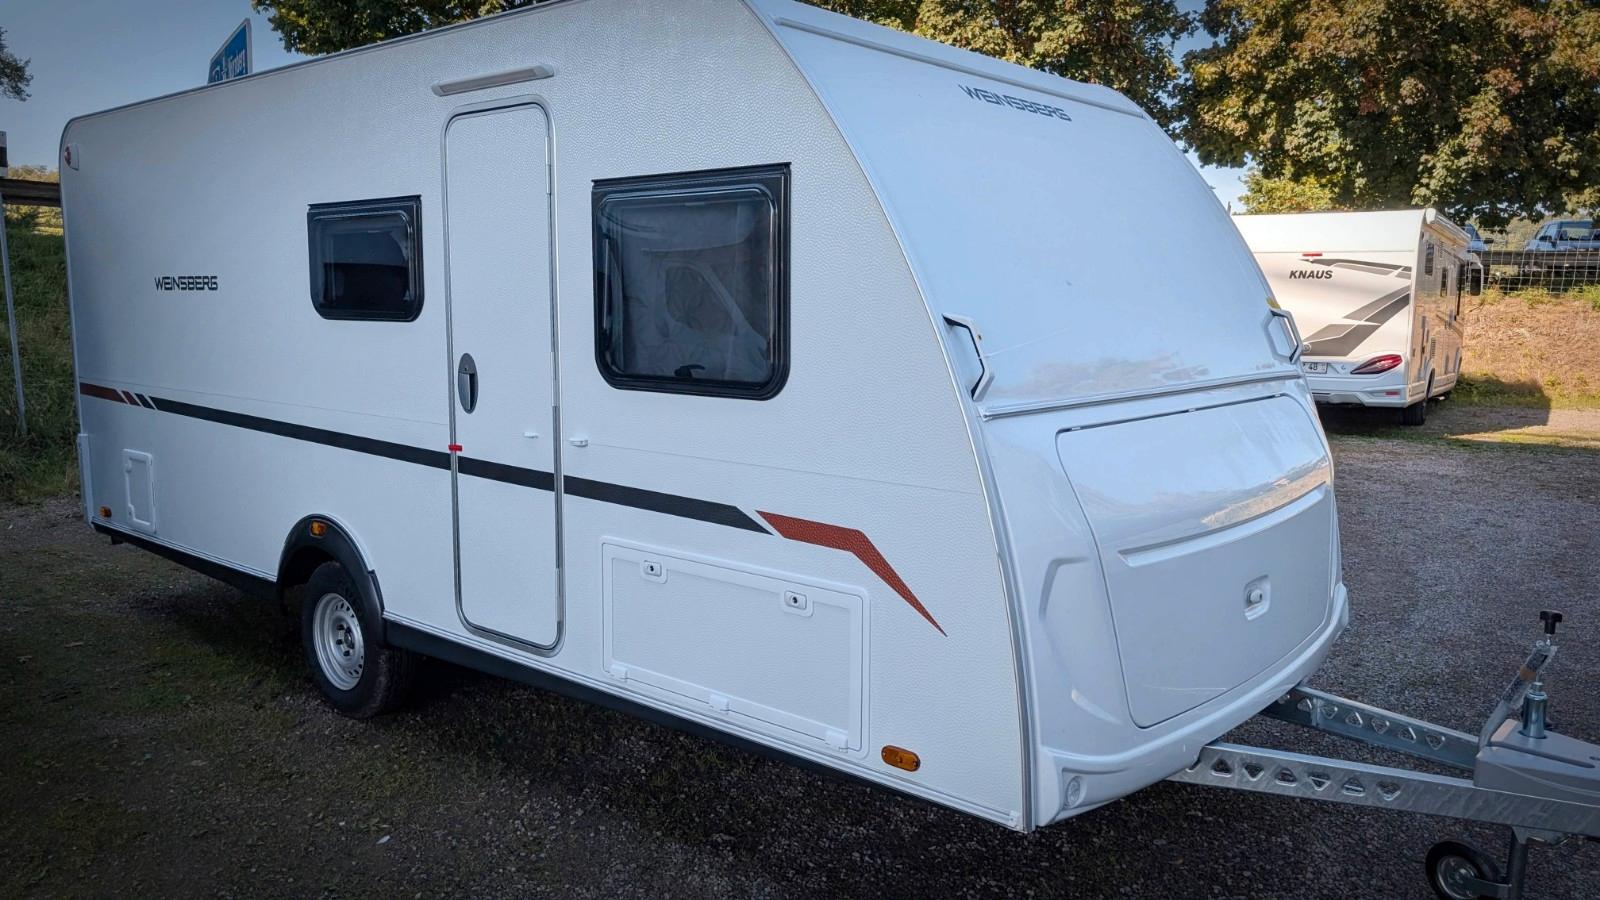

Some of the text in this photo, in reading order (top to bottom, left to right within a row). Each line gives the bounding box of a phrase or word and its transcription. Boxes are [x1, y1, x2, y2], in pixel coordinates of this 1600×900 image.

[958, 84, 1072, 121] WEINSBERG
[1289, 270, 1333, 279] KNAUS
[154, 275, 219, 291] WEINSBERG
